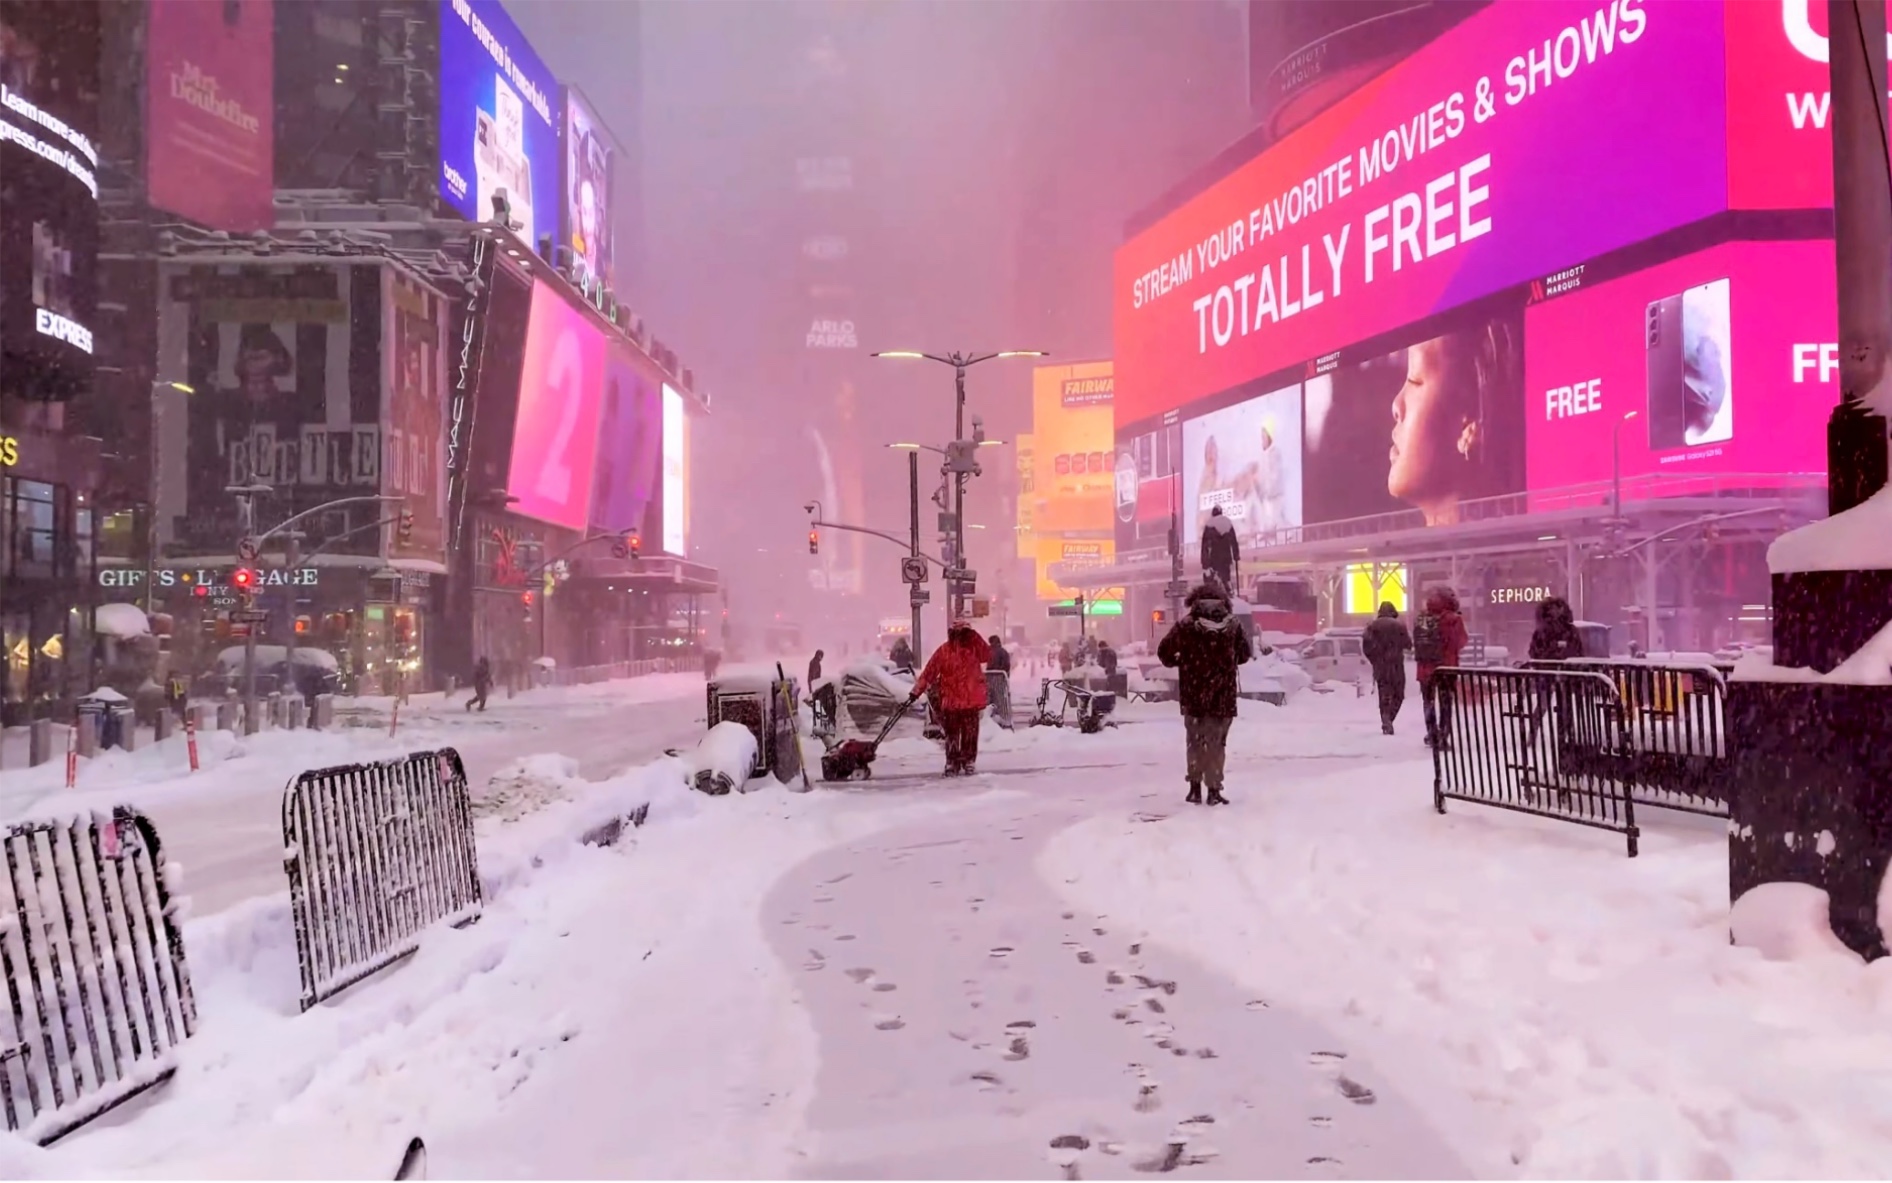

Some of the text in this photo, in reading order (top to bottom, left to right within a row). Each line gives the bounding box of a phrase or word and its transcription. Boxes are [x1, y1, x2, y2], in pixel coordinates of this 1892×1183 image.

[472, 13, 503, 68] courage
[1, 83, 38, 122] Learn
[37, 109, 69, 140] more
[1132, 0, 1647, 309] STREAM YOUR FAVORITE MOVIES & SHOWS
[1193, 153, 1492, 354] TOTALLY FREE
[1546, 264, 1585, 286] MARRIOTT
[1546, 278, 1580, 297] MARQUIS
[36, 308, 93, 355] EXPRESS
[806, 332, 858, 348] PARKS
[810, 319, 855, 335] ARLO
[1546, 377, 1602, 421] FREE
[447, 396, 465, 469] MAC
[99, 569, 175, 586] GIFS
[1491, 586, 1551, 604] SEPHORA
